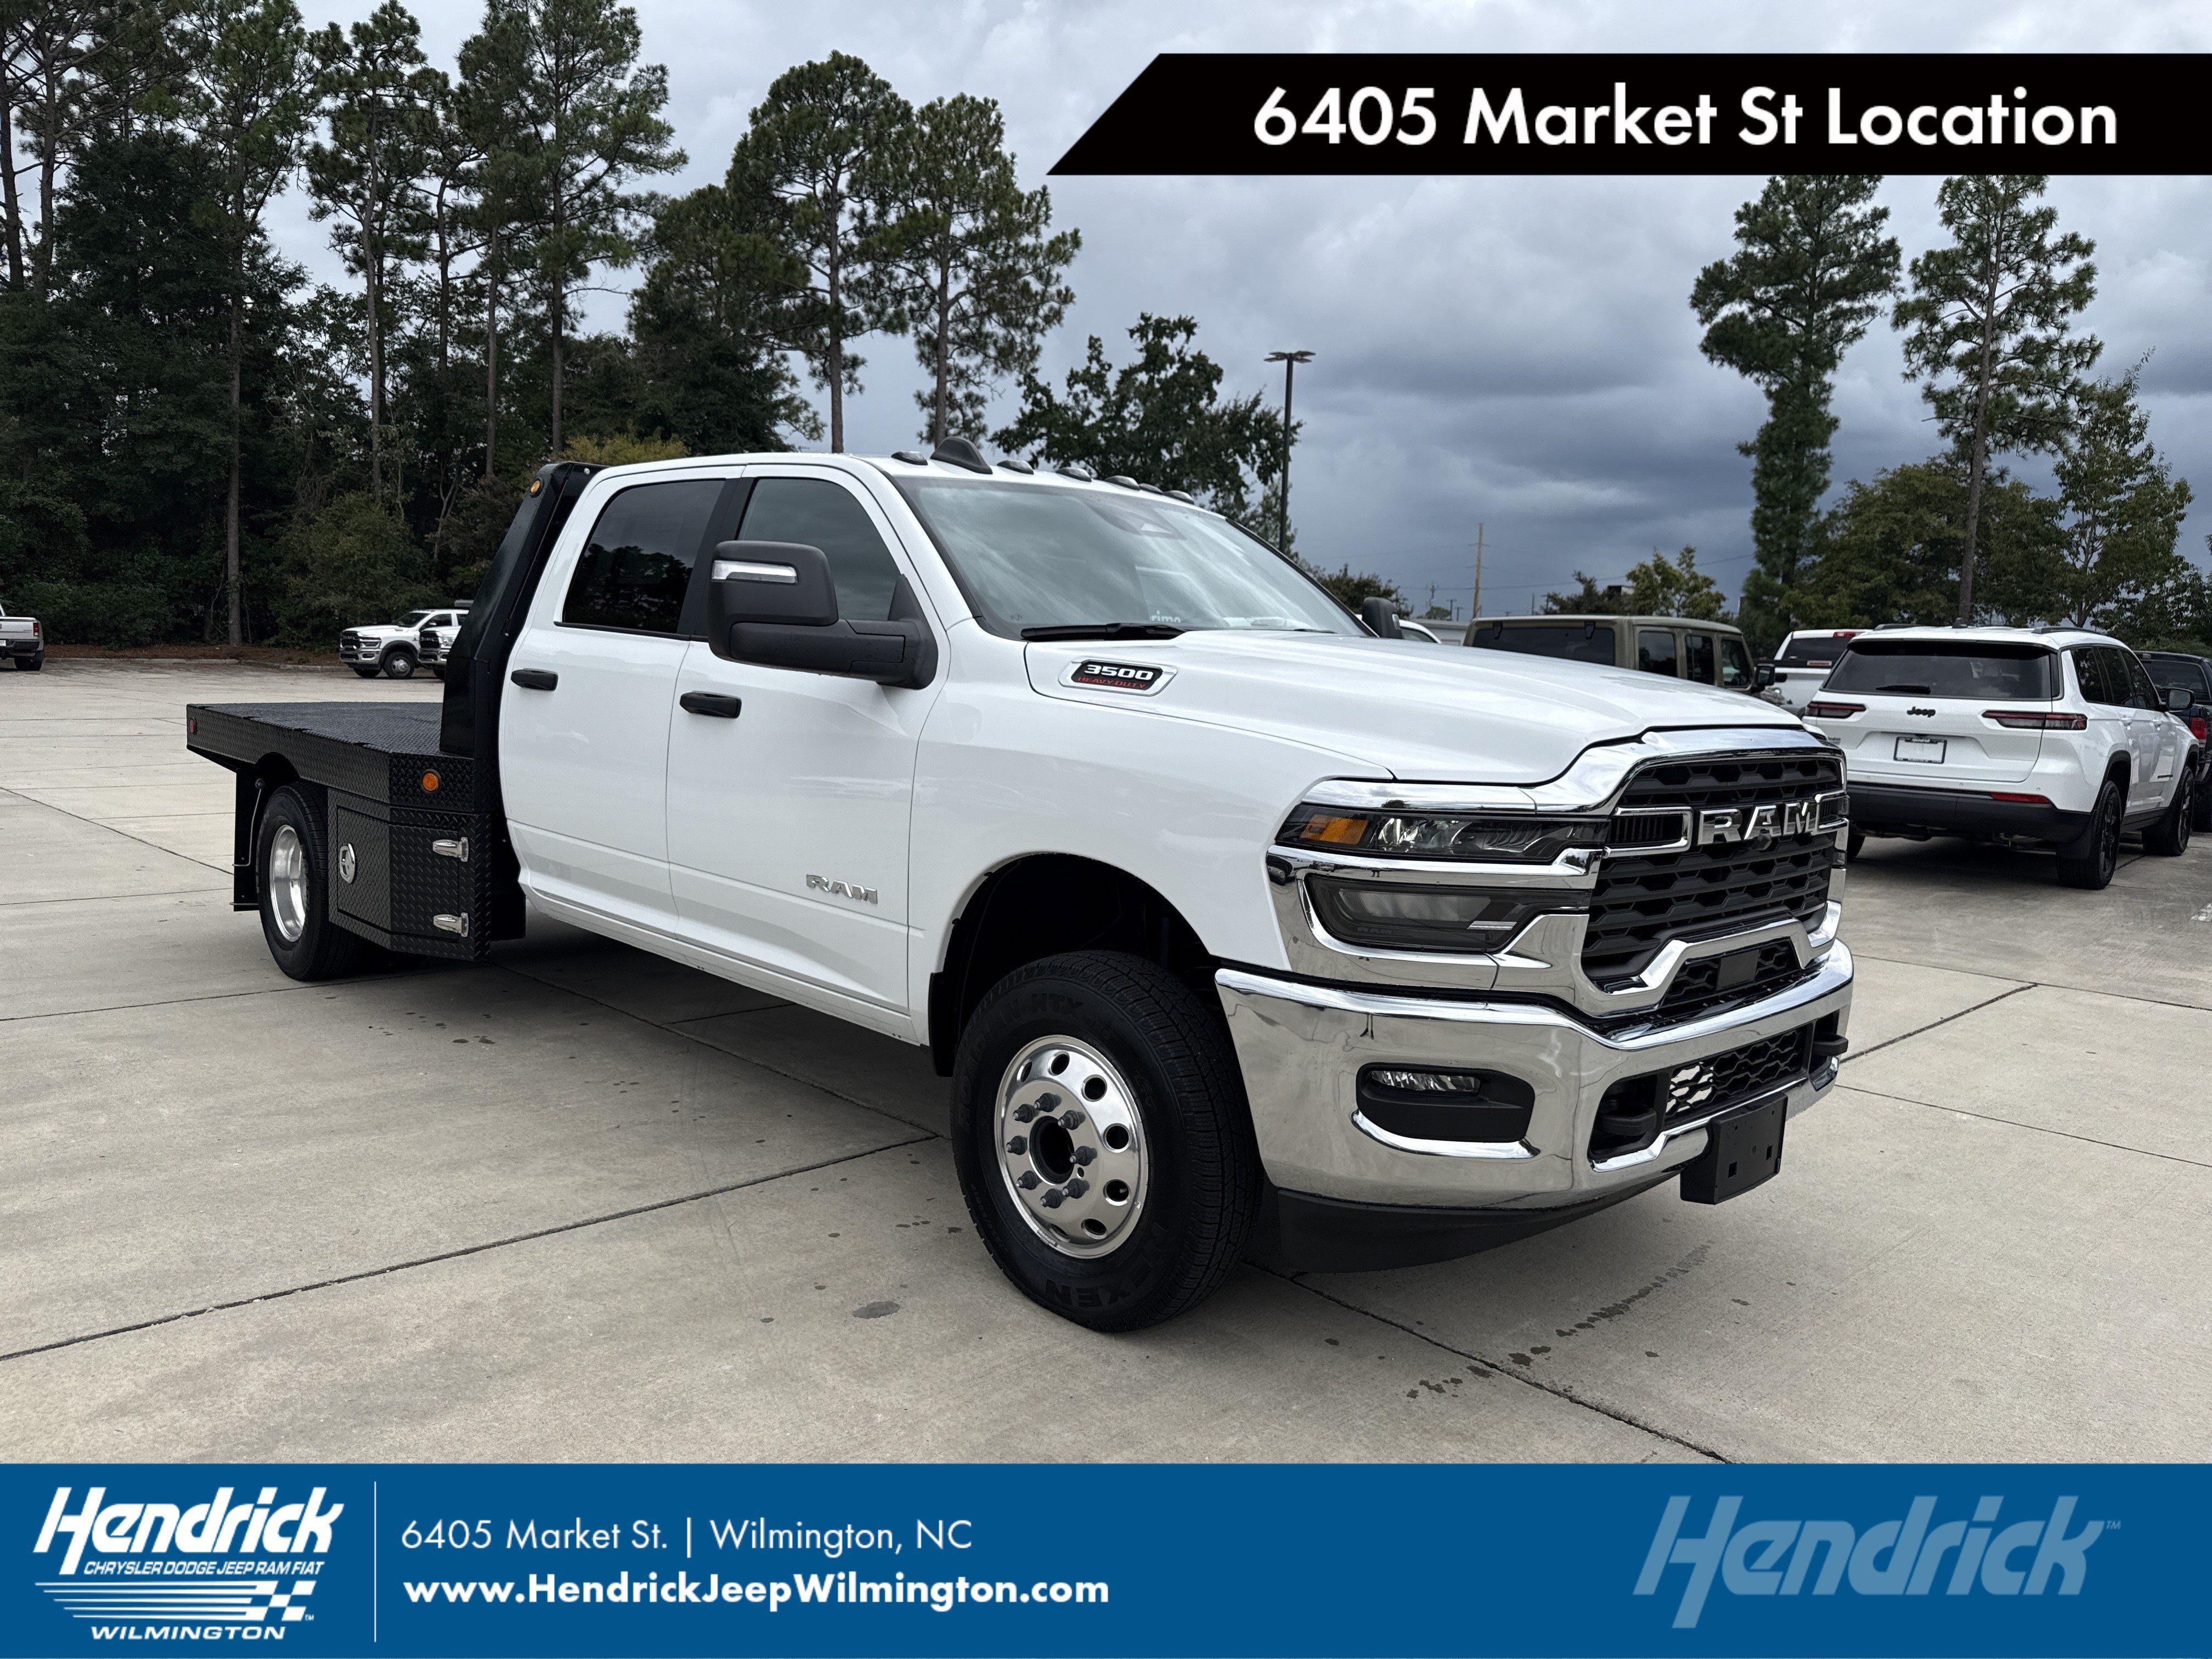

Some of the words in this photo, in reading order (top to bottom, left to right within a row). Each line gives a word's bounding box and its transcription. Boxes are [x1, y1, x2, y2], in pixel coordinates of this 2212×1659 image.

[1084, 664, 1153, 680] 3500
[1077, 676, 1113, 685] HEAVY
[1114, 681, 1147, 689] DUTY
[1906, 706, 1936, 718] Jeep
[1697, 802, 1817, 845] RAM
[806, 873, 878, 905] RAM
